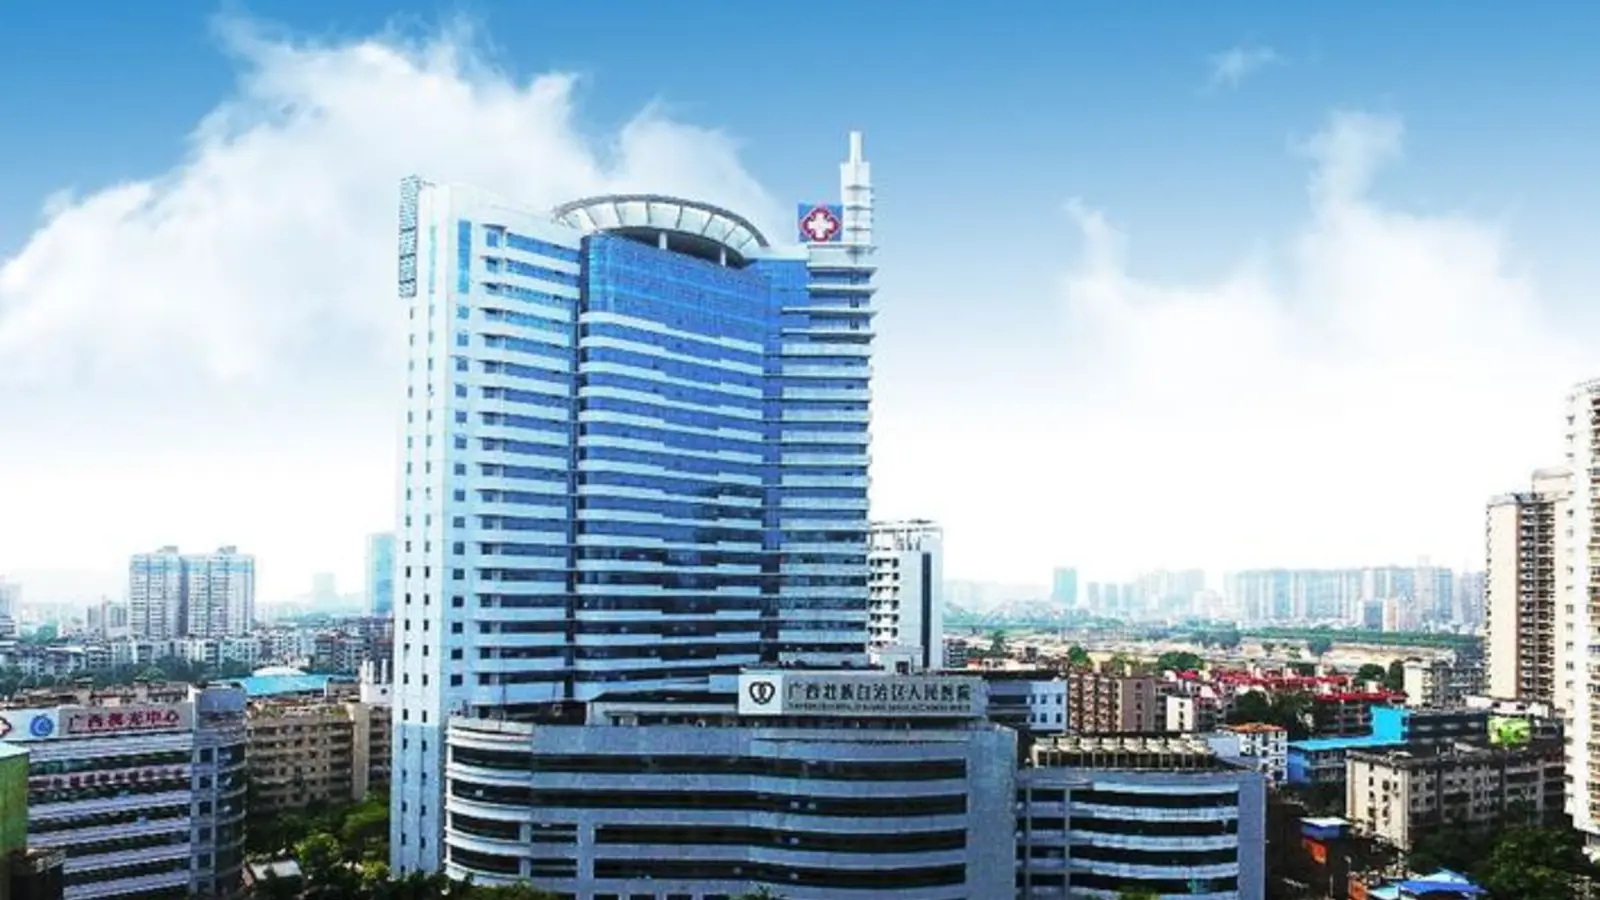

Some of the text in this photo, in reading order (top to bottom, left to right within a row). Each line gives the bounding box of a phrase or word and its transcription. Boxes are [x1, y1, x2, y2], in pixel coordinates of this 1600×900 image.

[787, 682, 971, 701] 广西壮族自治区人民医院
